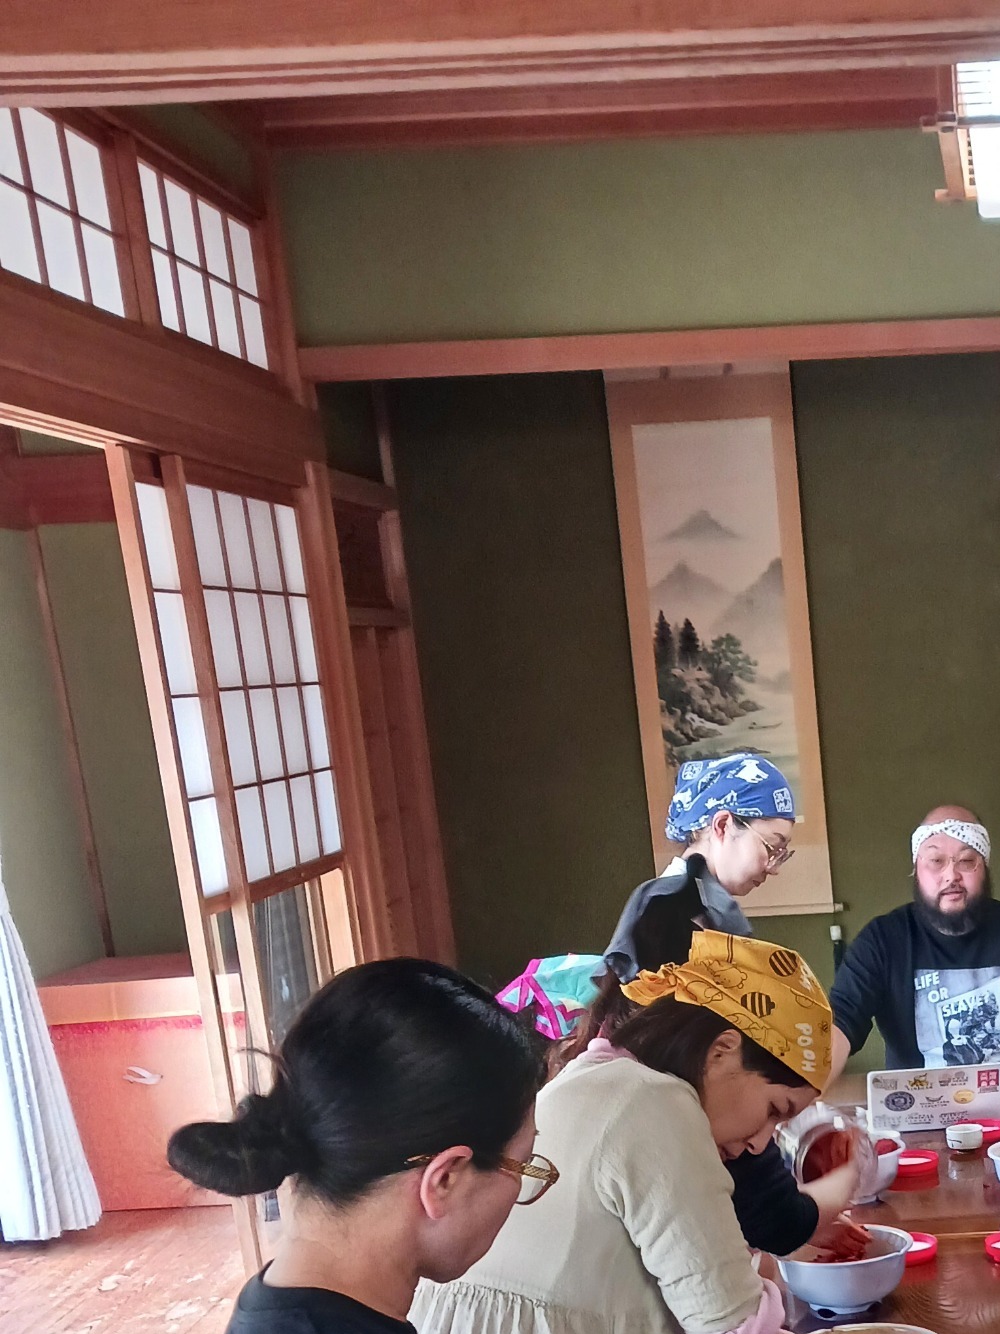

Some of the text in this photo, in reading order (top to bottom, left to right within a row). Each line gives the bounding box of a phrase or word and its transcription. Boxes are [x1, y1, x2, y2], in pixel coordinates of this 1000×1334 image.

[914, 971, 939, 990] LIFE
[928, 987, 949, 1003] OR
[795, 1023, 817, 1072] POOH
